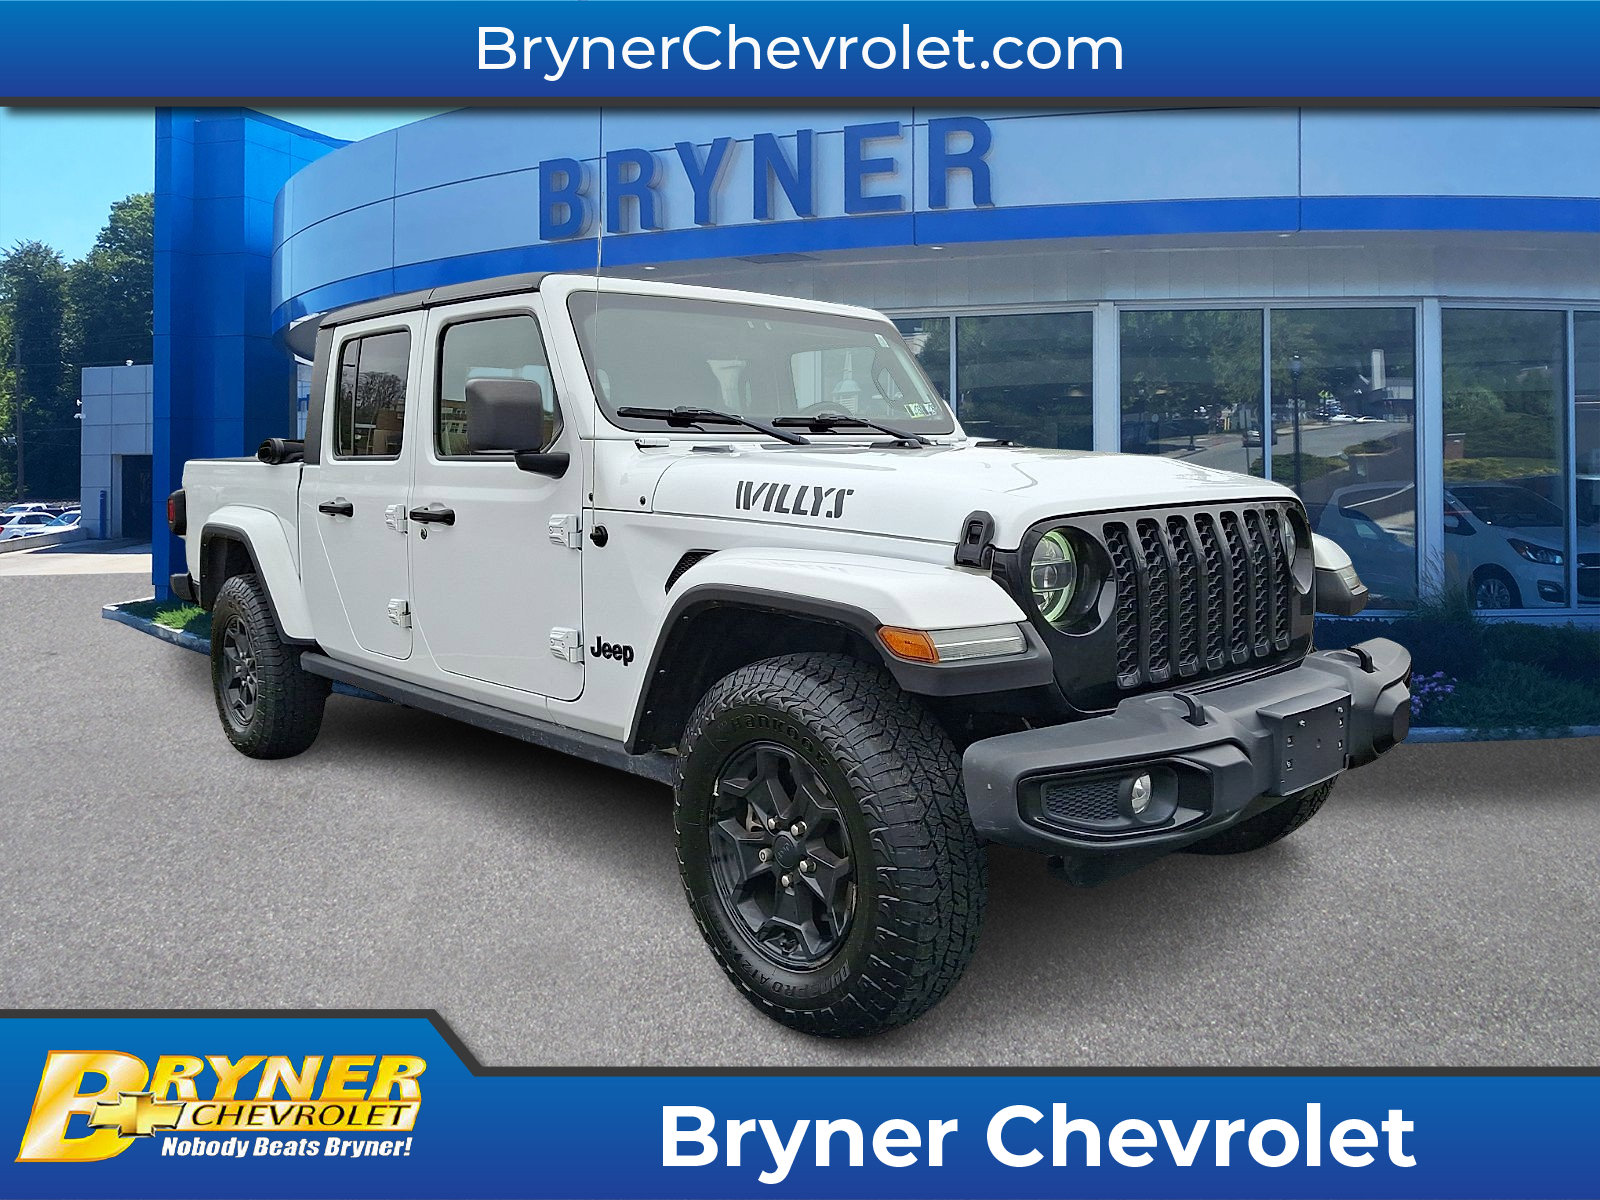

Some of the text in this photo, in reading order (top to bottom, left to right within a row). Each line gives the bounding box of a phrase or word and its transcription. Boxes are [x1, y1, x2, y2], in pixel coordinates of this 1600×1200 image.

[538, 116, 994, 241] BRYNER
[735, 480, 855, 519] WILLYS
[590, 635, 635, 667] Jeep
